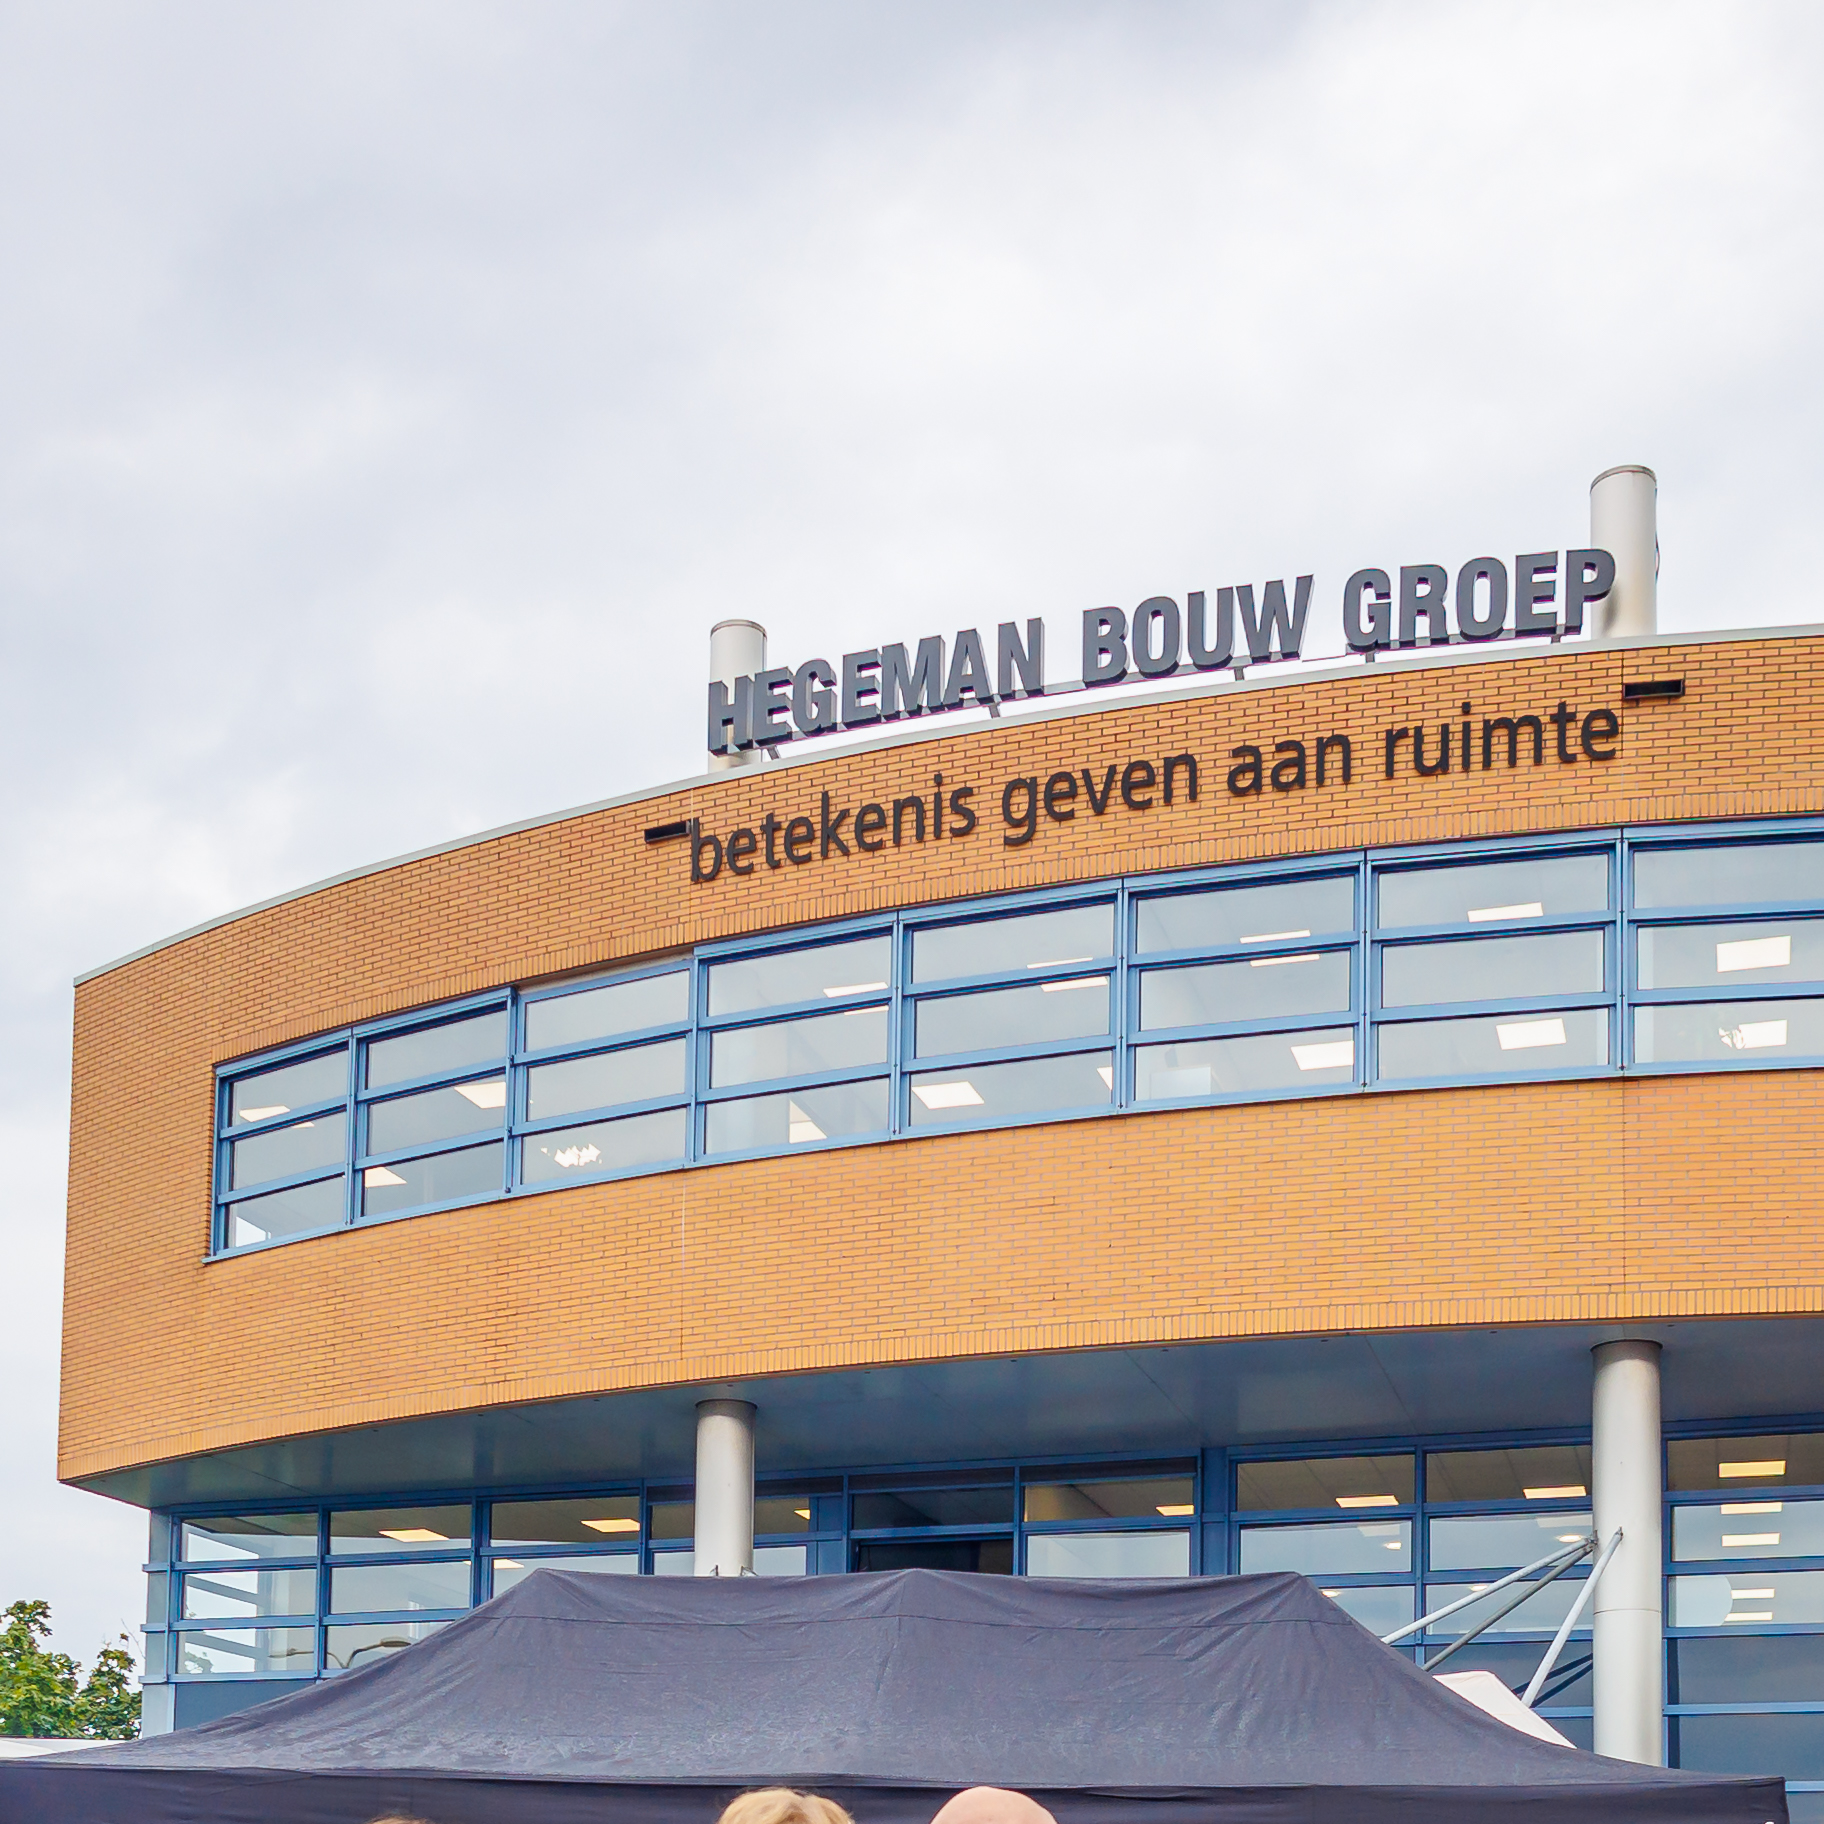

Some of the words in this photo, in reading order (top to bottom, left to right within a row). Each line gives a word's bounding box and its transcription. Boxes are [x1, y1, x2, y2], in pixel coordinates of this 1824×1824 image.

[708, 617, 1045, 756] HEGEMAN
[1082, 574, 1314, 688] BOUW
[1343, 548, 1616, 653] GROEP
[690, 773, 977, 883] betekenis
[1002, 750, 1198, 846] geven
[1227, 731, 1352, 797] aan
[1385, 701, 1620, 780] ruimte
